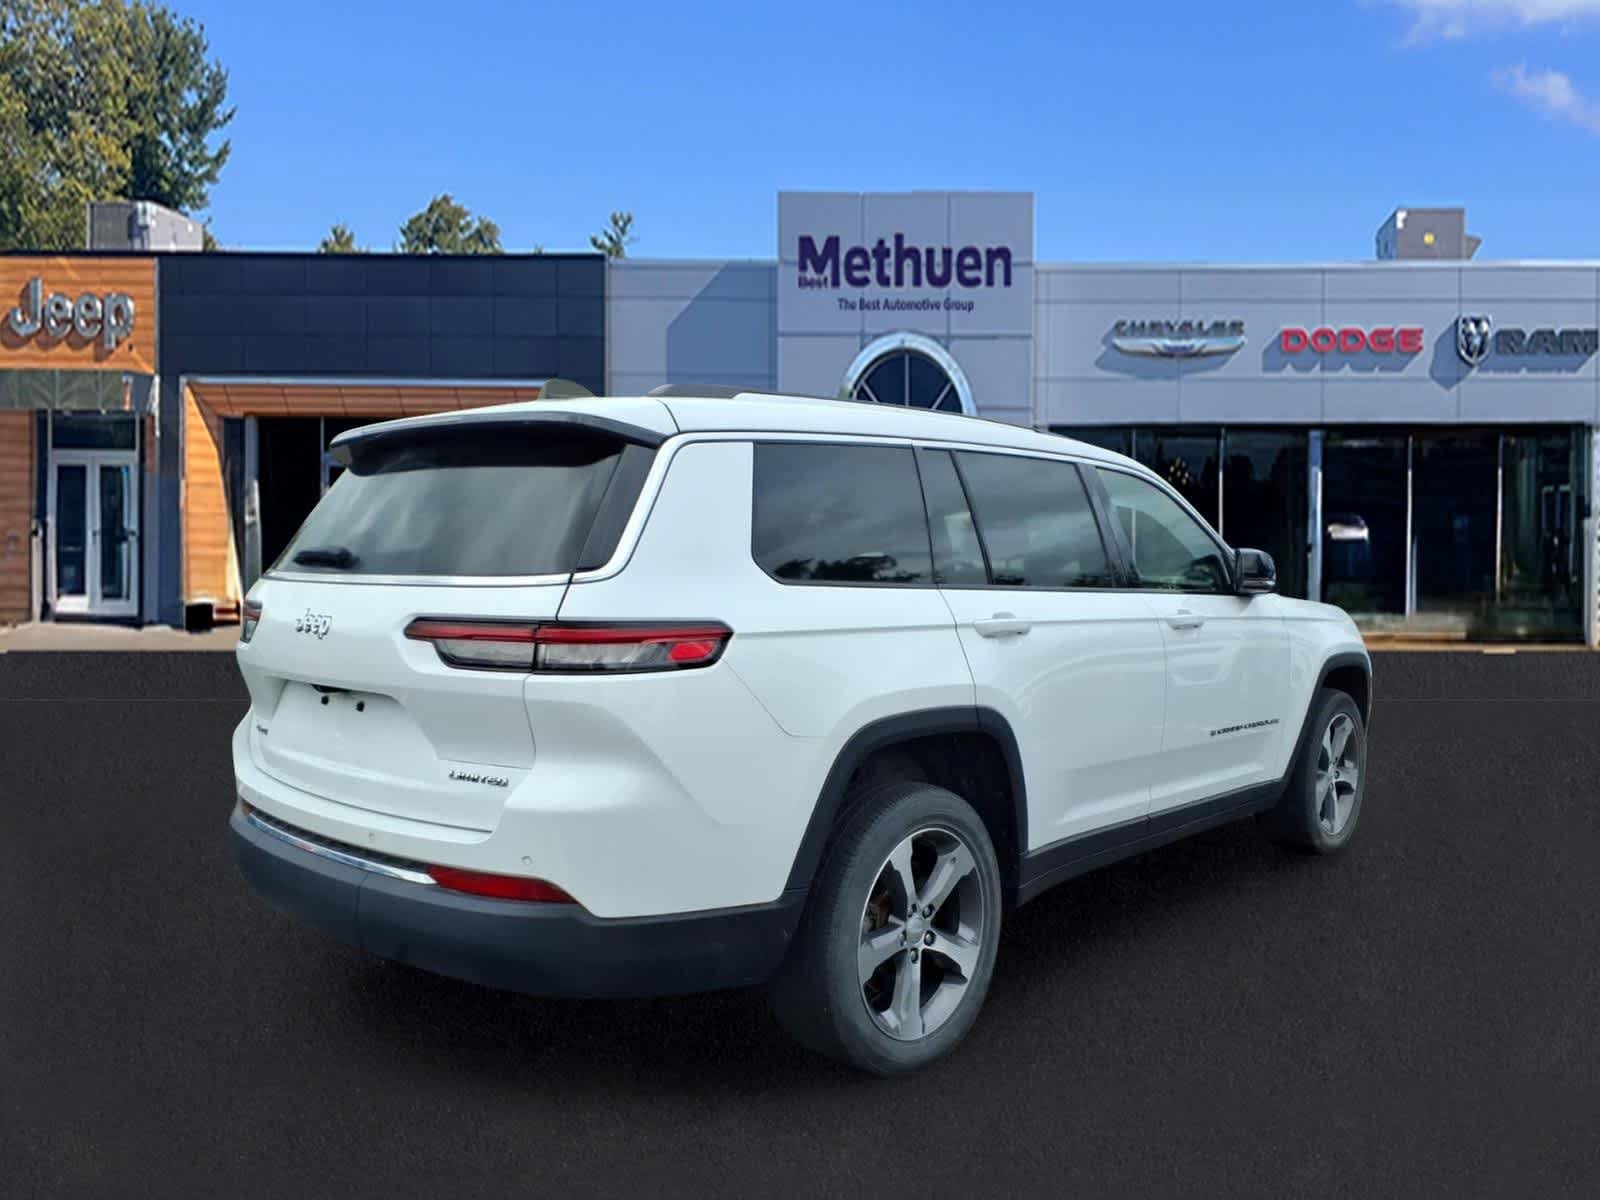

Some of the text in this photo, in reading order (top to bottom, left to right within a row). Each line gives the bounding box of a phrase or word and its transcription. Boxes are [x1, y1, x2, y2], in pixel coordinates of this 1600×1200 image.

[798, 233, 1012, 288] Methuen
[9, 277, 135, 349] Jeep
[838, 298, 975, 314] The Best Automotive Group
[1281, 327, 1424, 353] DODGE
[1495, 329, 1598, 353] RAM
[295, 608, 332, 640] Jeep
